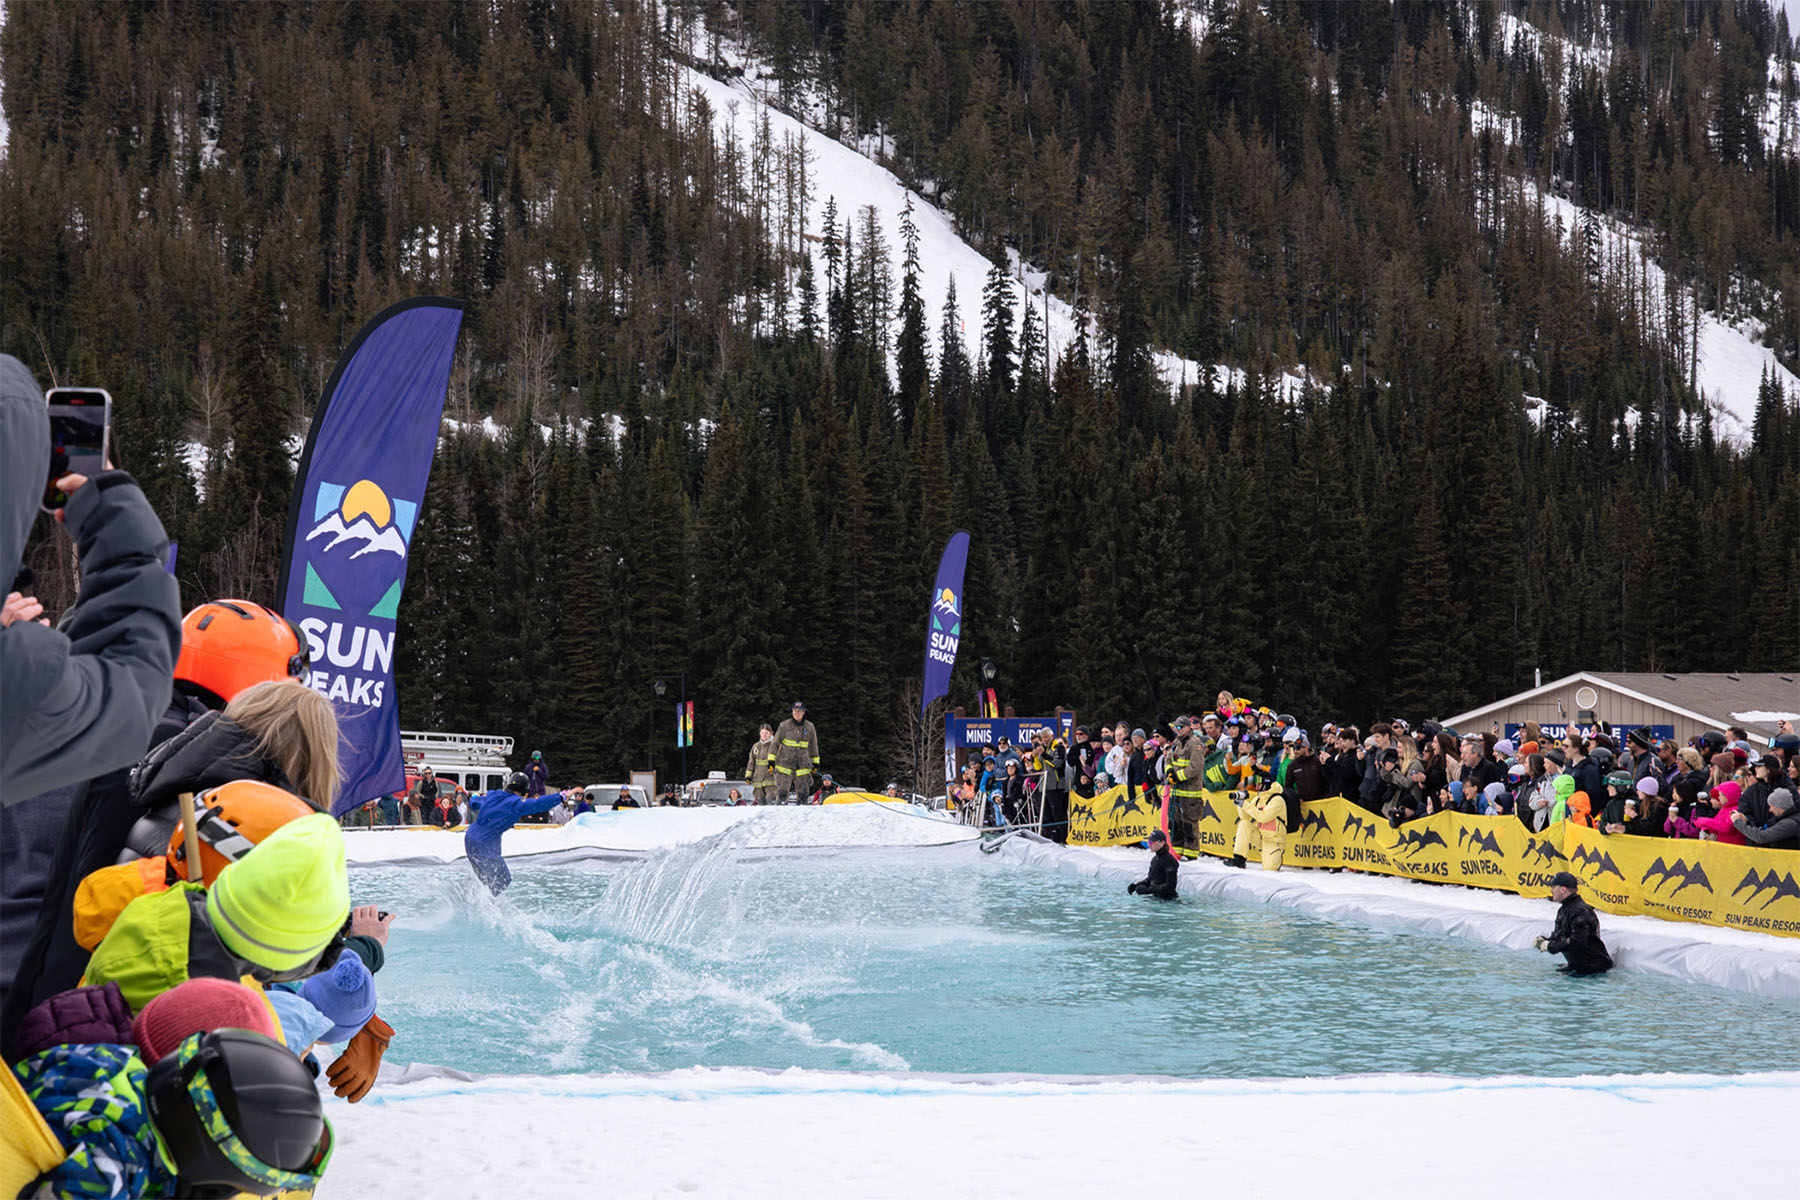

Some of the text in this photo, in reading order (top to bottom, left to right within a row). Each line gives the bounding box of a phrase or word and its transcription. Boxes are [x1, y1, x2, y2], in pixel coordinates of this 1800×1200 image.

[299, 617, 395, 674] SUN
[930, 632, 959, 654] SUN
[929, 648, 955, 665] PEAKS
[966, 729, 992, 743] MINIS
[1123, 825, 1148, 838] EAKS
[1200, 832, 1226, 845] EAKS
[1294, 844, 1336, 860] SUN PEAKS
[1342, 846, 1363, 861] SUN
[1461, 860, 1506, 876] SUN PEA
[1682, 907, 1713, 920] RESORT
[1725, 913, 1741, 924] SUN
[1742, 915, 1771, 929] PEAKS
